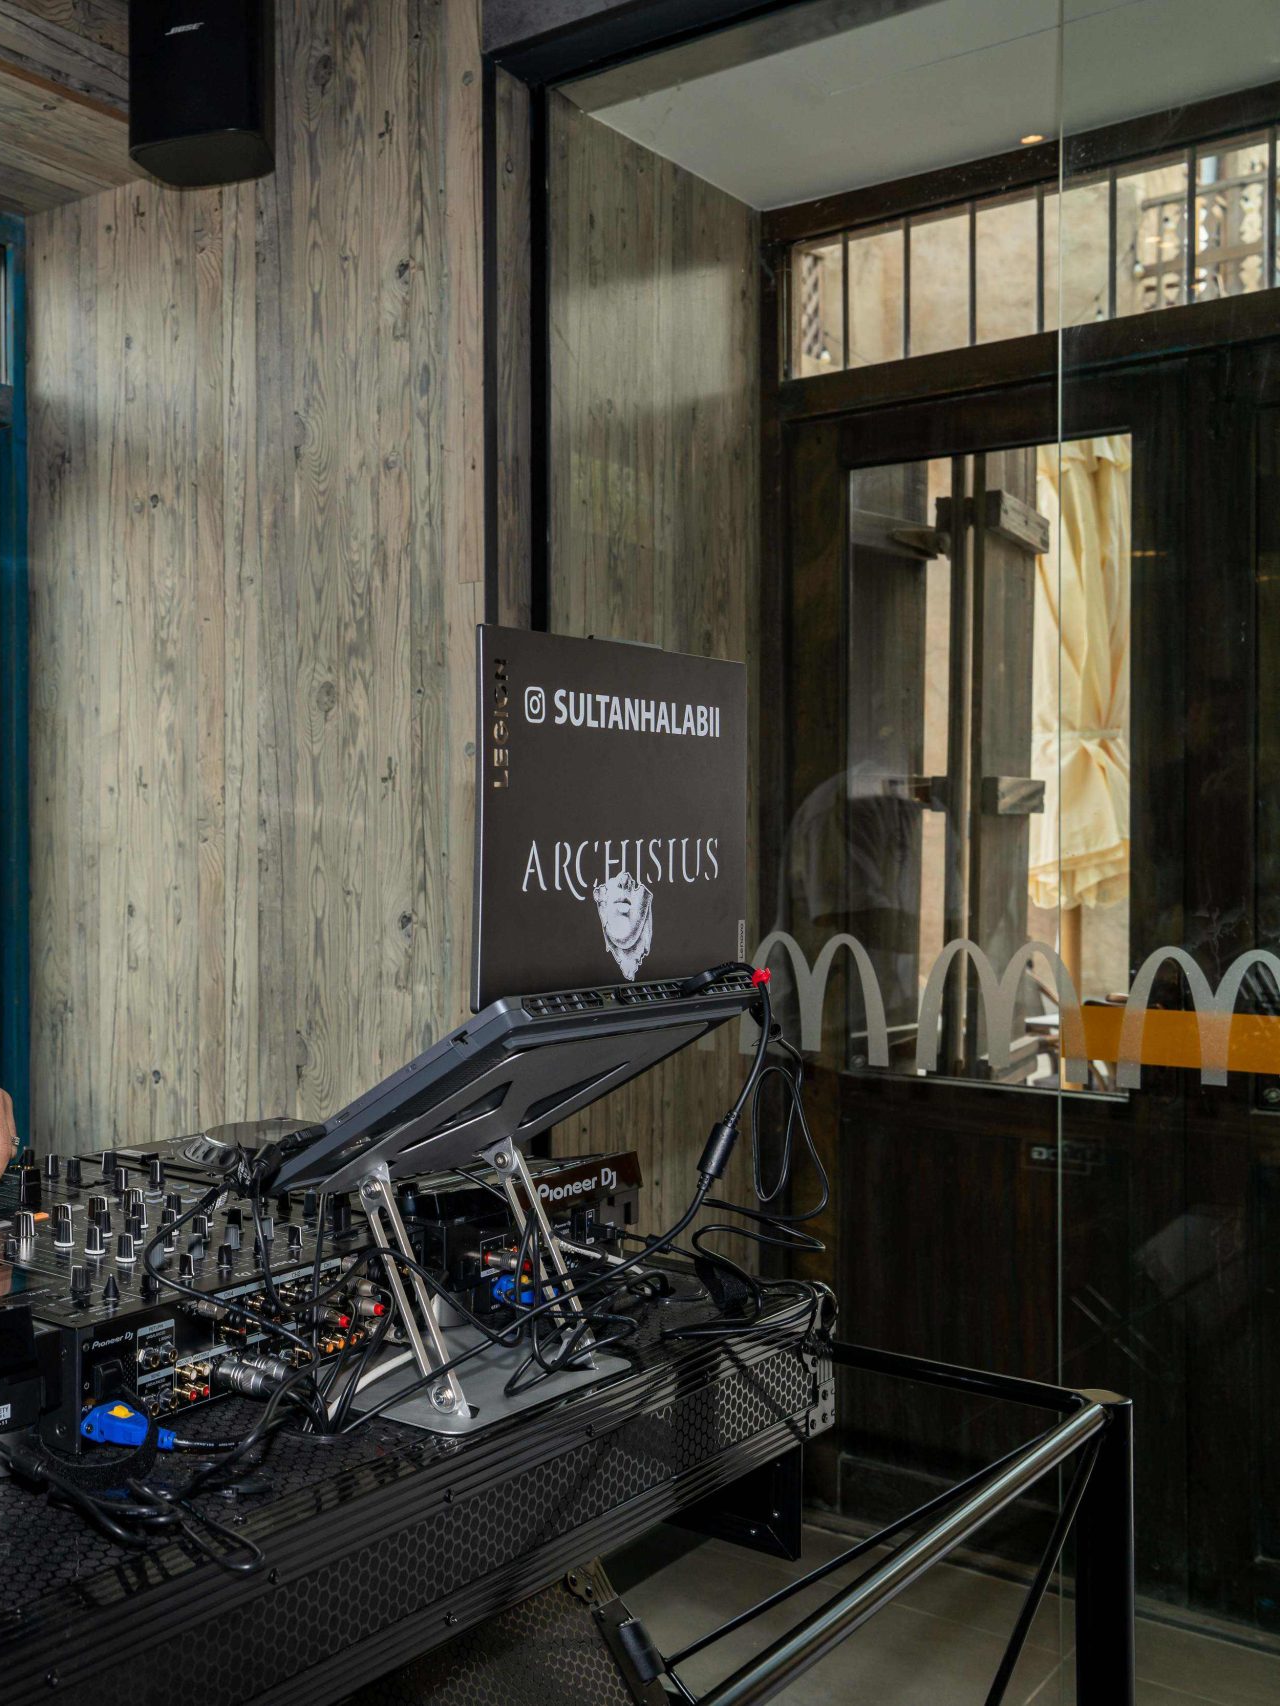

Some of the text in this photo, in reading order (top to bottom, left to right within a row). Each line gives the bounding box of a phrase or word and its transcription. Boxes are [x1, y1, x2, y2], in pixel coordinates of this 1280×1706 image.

[164, 22, 205, 36] BOSE
[493, 658, 509, 788] LEGION
[554, 689, 720, 737] SULTANHALABII
[537, 1176, 598, 1202] Pioneer
[91, 1335, 124, 1350] Pioneer
